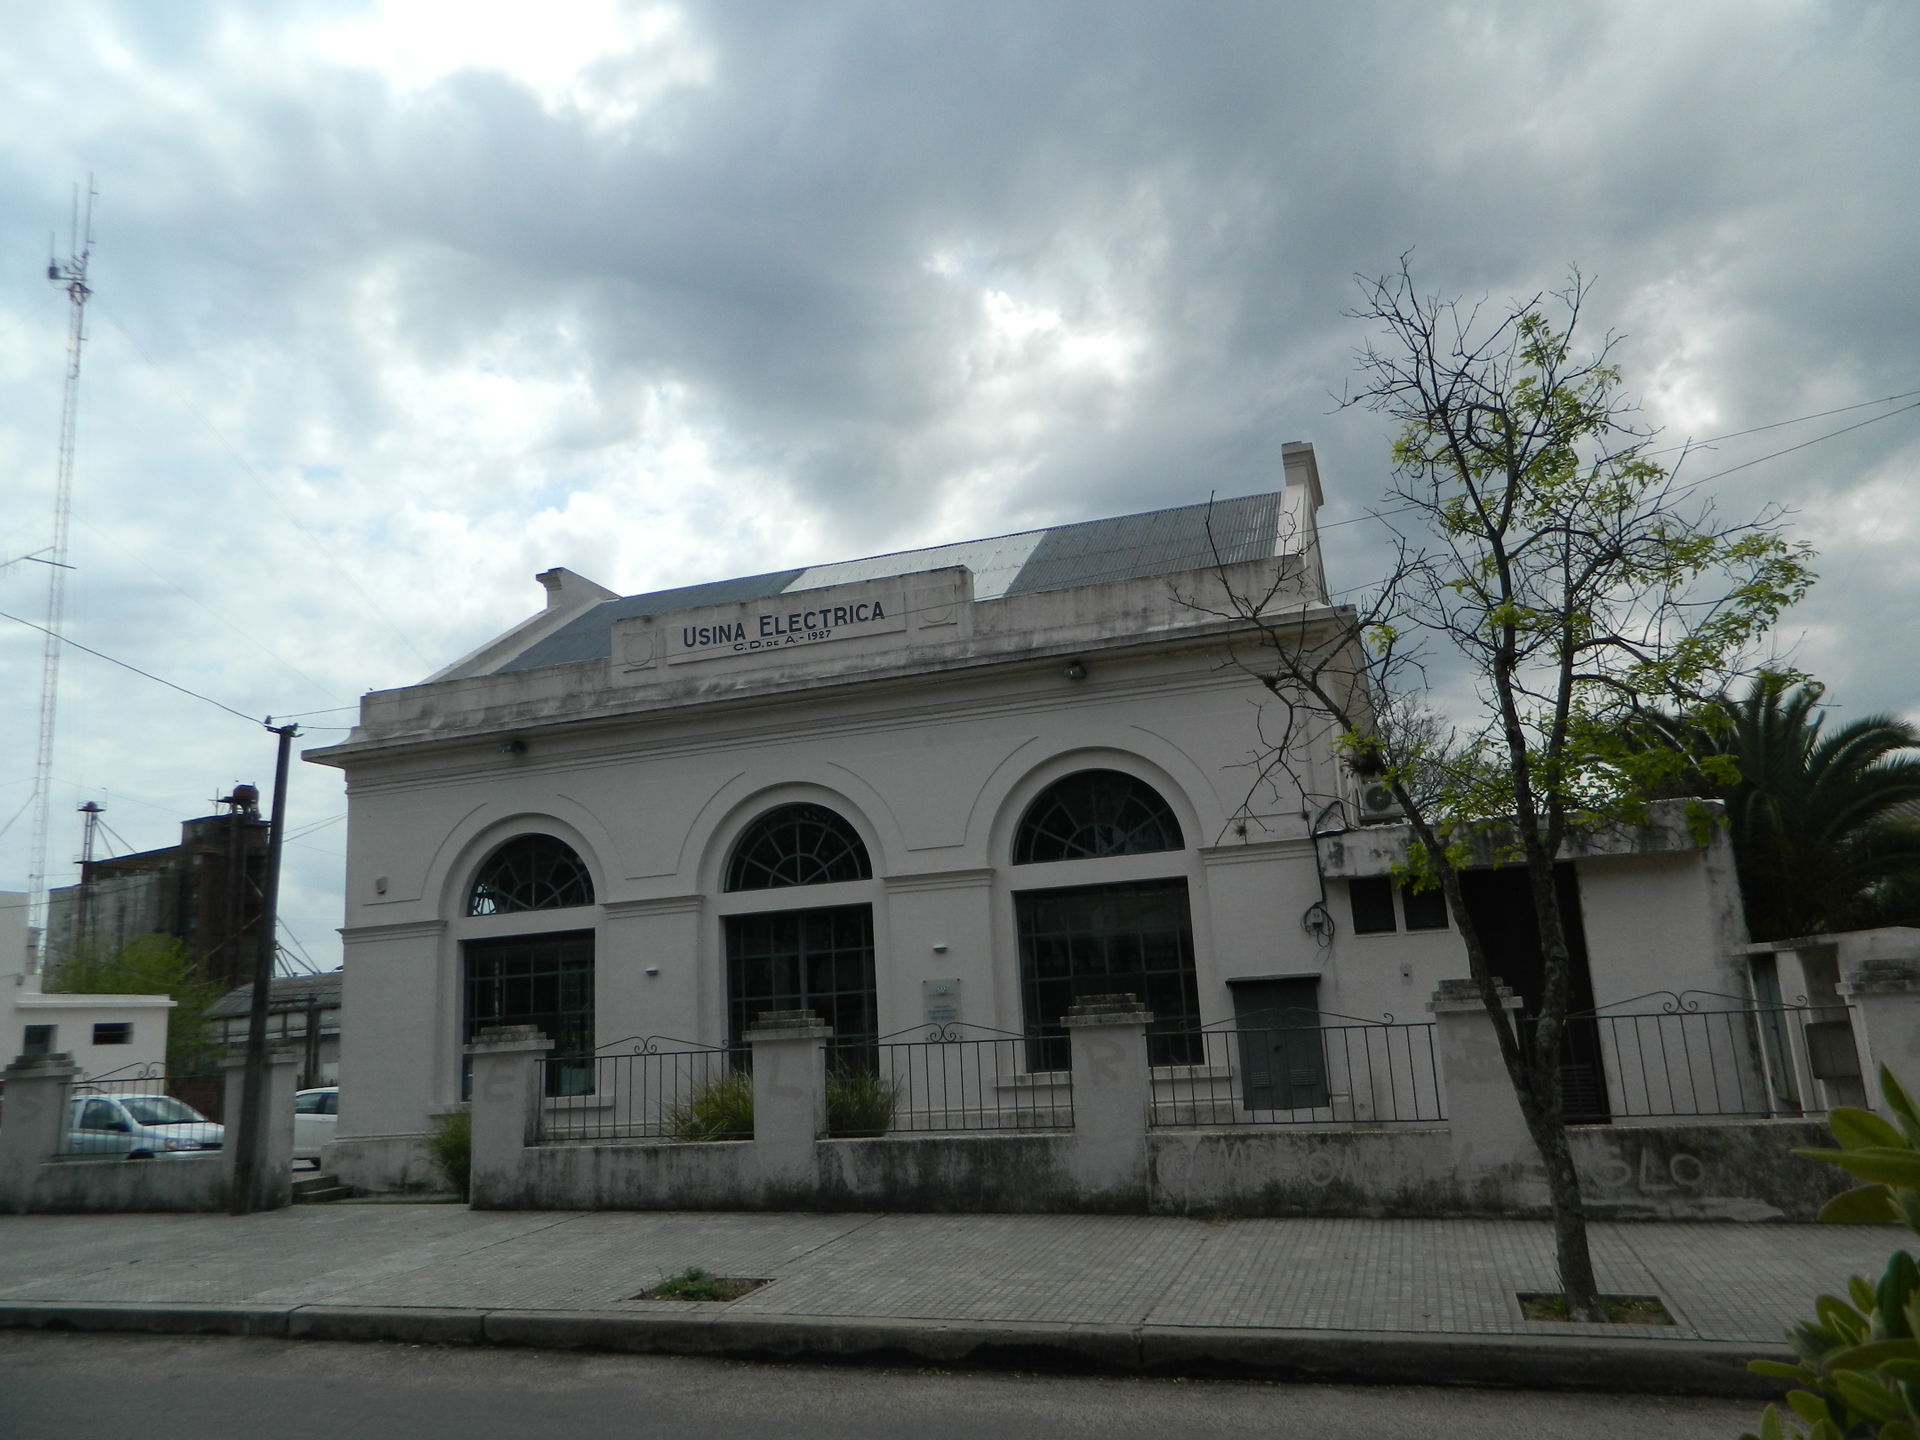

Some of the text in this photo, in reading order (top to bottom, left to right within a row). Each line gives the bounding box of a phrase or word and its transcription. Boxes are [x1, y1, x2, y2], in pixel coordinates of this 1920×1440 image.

[683, 601, 885, 648] USINA ELECTRICA
[807, 629, 832, 641] 1927
